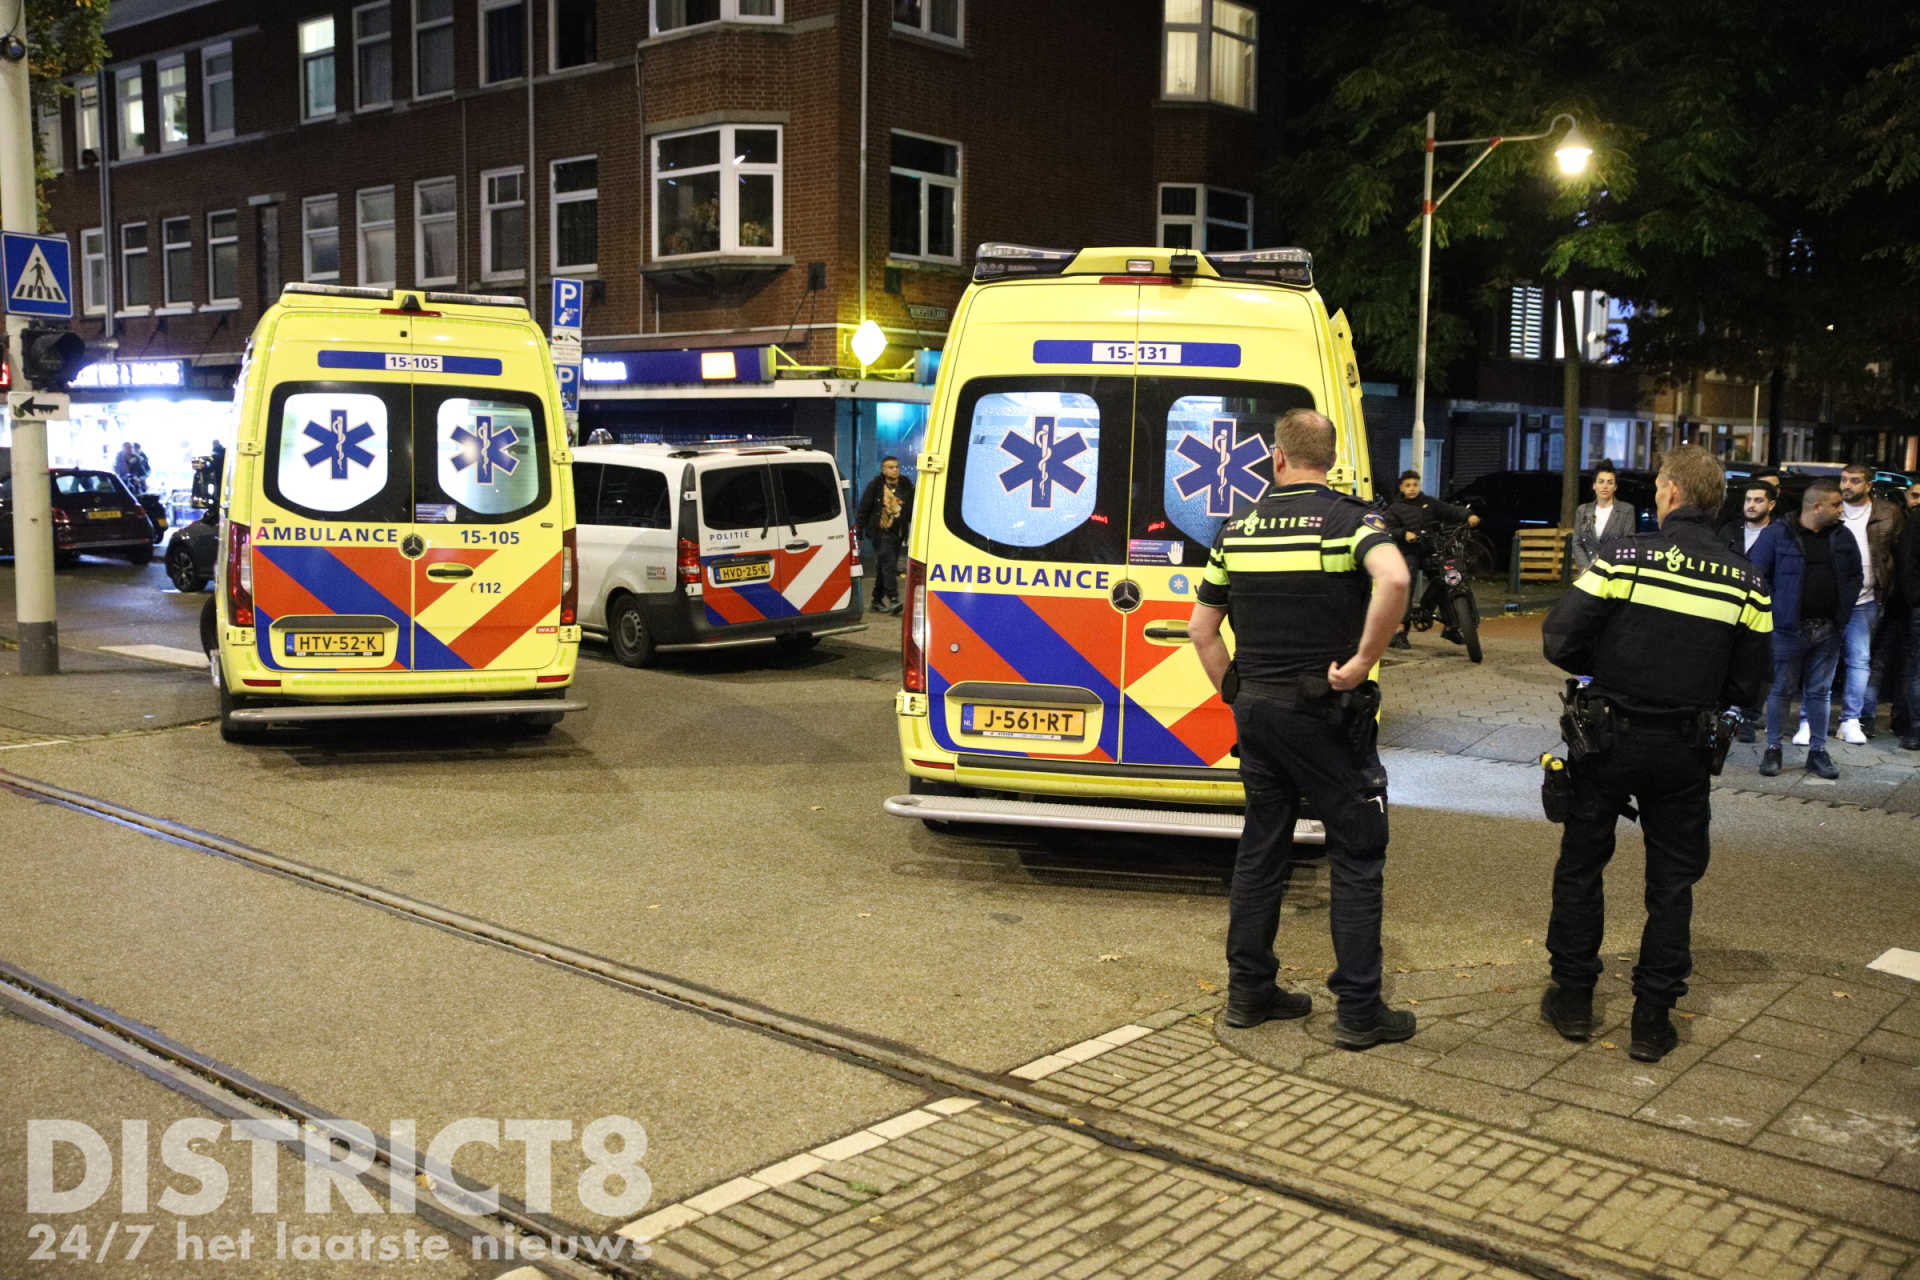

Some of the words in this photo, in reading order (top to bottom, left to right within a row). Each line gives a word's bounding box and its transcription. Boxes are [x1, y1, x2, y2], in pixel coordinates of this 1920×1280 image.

[560, 283, 578, 309] P
[1108, 346, 1167, 360] 15-131
[390, 356, 438, 369] 15-105
[255, 526, 398, 543] AMBULANCE
[460, 530, 520, 545] 15-105
[709, 530, 750, 541] POLITIE
[722, 564, 768, 578] HVD-25-K
[929, 564, 1109, 590] AMBULANCE
[478, 582, 502, 594] 112
[300, 636, 376, 650] HTV-52-K
[985, 709, 1073, 732] J-561-RT
